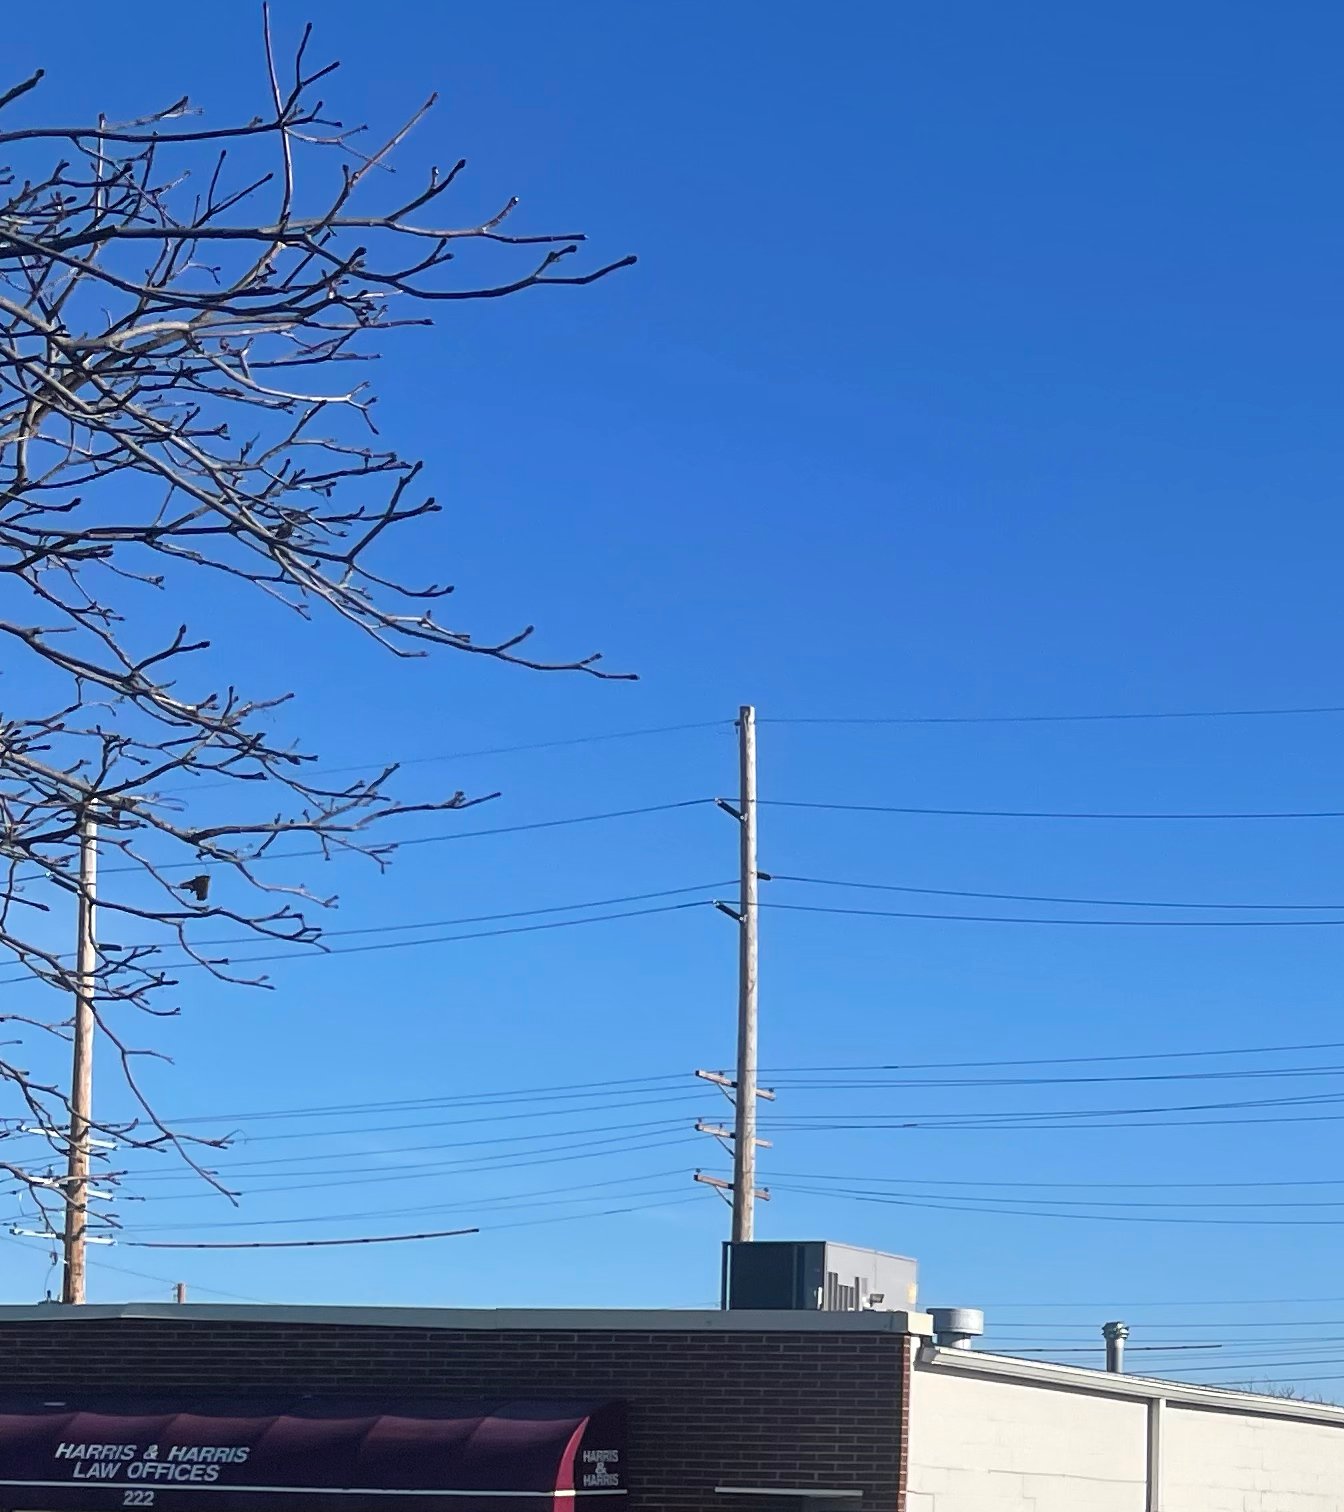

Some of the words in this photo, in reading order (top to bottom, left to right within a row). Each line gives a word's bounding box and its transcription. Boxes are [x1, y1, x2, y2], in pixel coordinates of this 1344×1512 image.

[55, 1443, 137, 1460] HARRIS
[143, 1444, 159, 1460] &
[168, 1446, 250, 1463] HARRIS
[583, 1449, 619, 1463] HARRIS
[73, 1461, 121, 1479] LAW
[127, 1462, 220, 1482] OFFICES
[595, 1462, 608, 1474] &
[583, 1473, 619, 1487] HARRIS
[123, 1490, 155, 1506] 222
